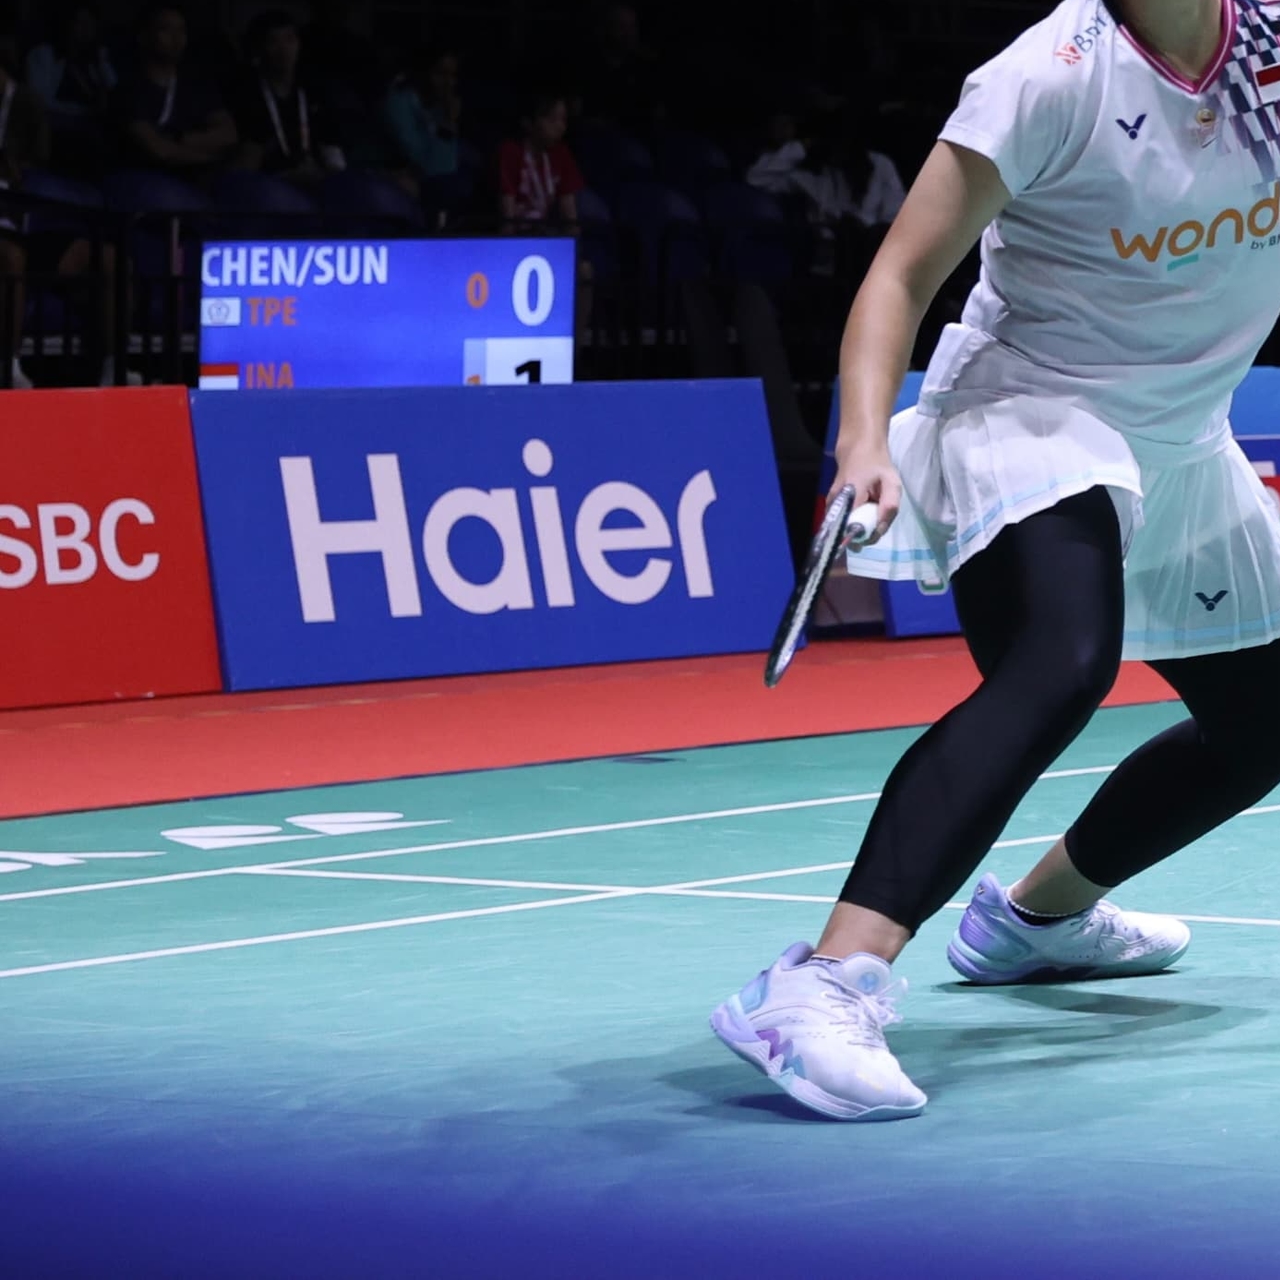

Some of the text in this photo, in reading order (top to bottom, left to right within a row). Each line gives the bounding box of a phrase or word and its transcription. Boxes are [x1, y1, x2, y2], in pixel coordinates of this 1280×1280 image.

[201, 246, 388, 287] CHEN/SUN
[466, 255, 555, 327] 0 0
[246, 297, 298, 327] TPE
[245, 362, 295, 389] INA
[279, 438, 717, 623] Haier
